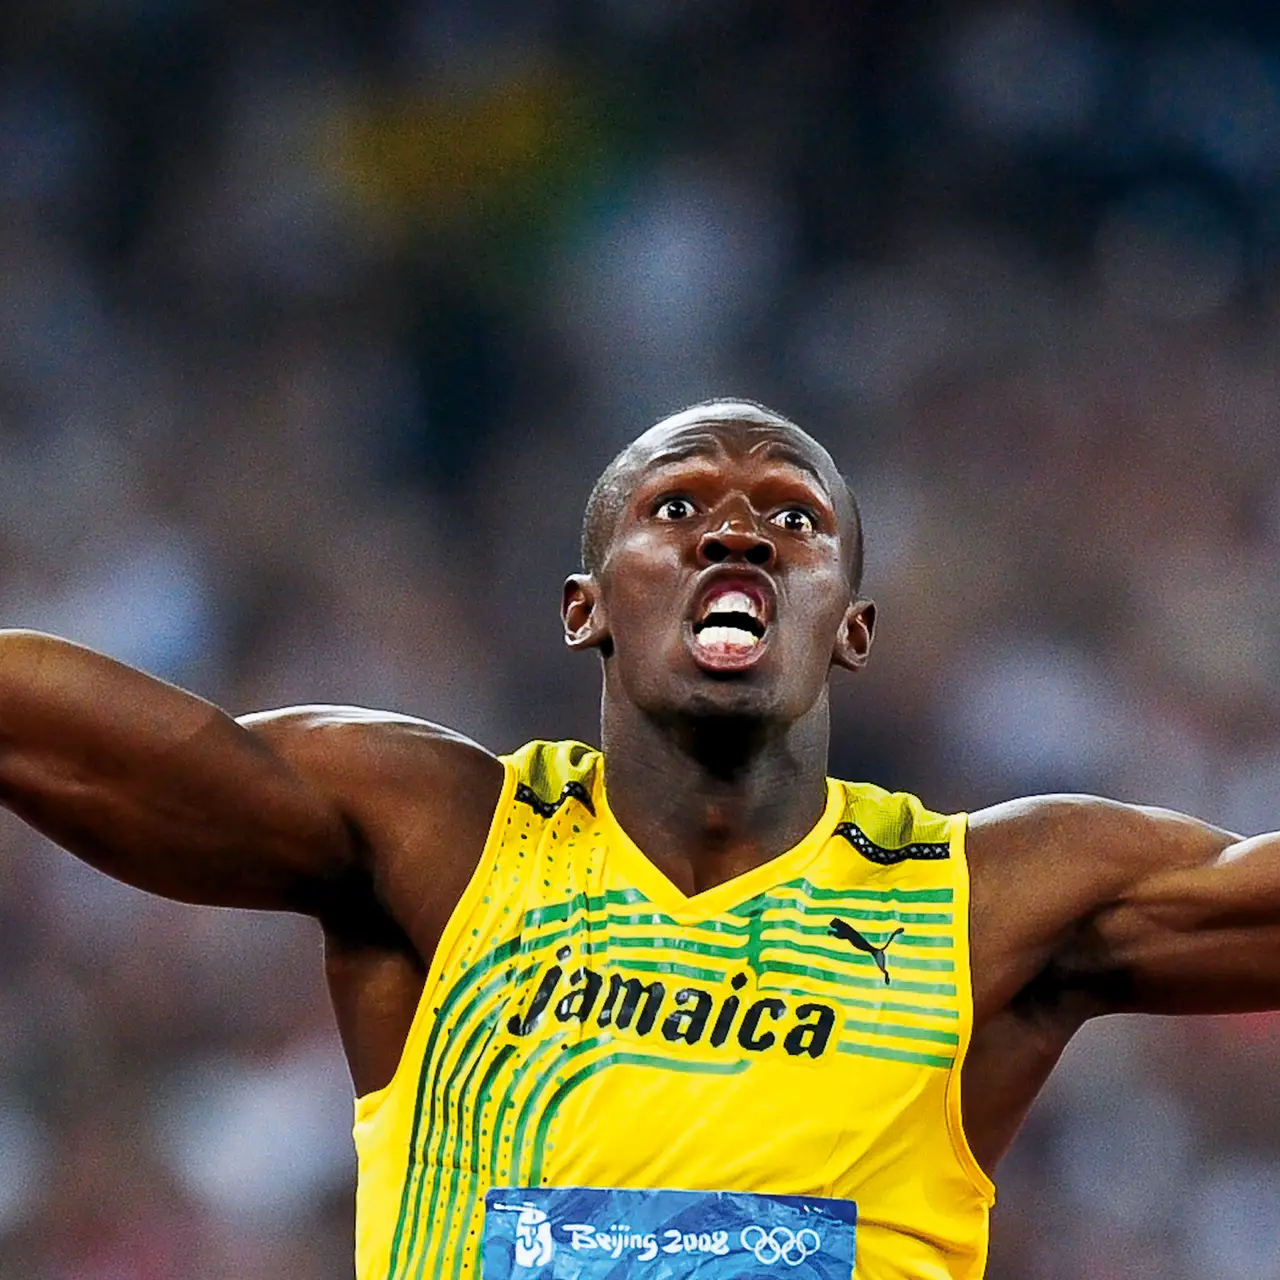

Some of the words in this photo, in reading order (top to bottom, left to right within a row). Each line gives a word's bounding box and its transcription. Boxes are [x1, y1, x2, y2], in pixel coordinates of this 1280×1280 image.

[506, 944, 836, 1060] jamaica
[561, 1223, 659, 1262] Beijing
[661, 1229, 731, 1255] 2008
